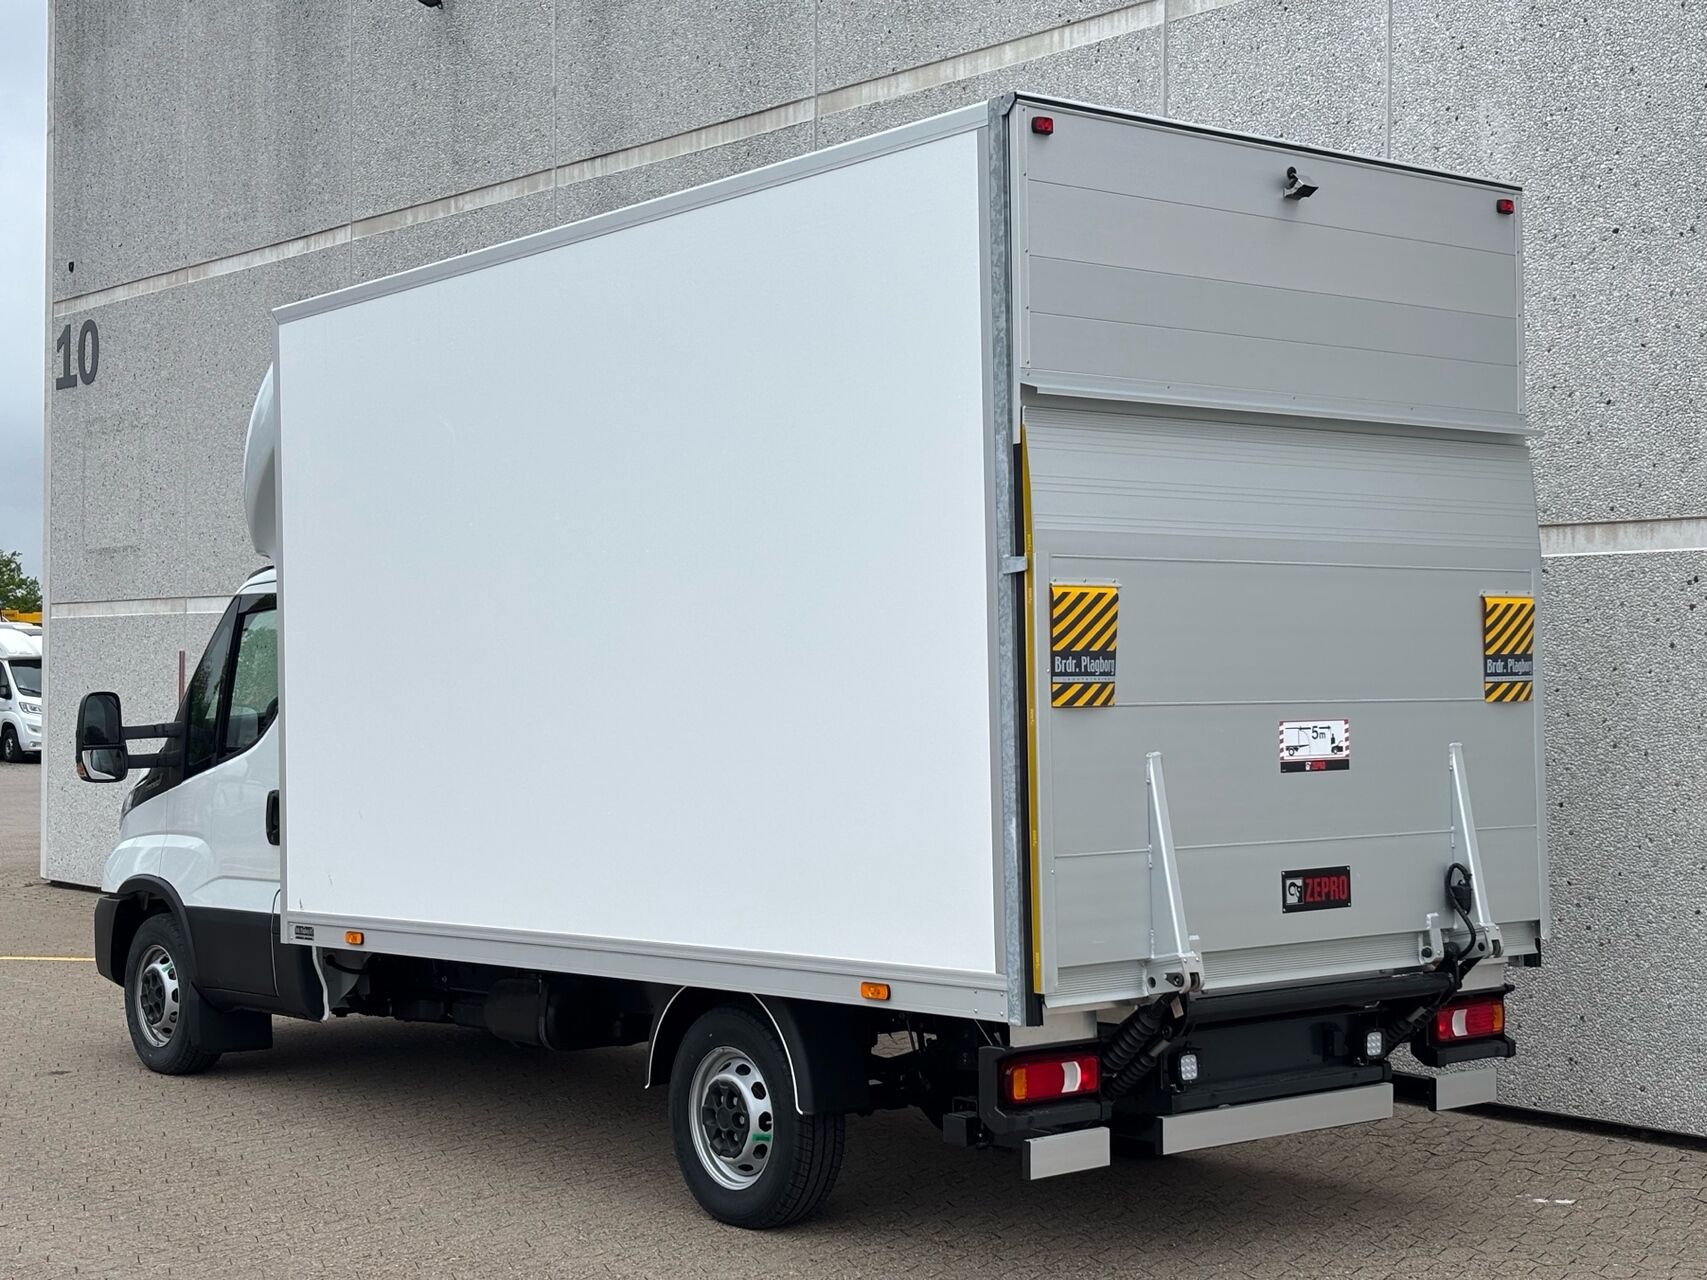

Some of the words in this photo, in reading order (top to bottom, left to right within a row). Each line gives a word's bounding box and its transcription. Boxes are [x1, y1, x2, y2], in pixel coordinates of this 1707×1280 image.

[56, 319, 99, 390] 10
[1054, 655, 1080, 673] Brdr.
[1486, 658, 1507, 673] Brdr.
[1305, 875, 1348, 902] ZEPRO
